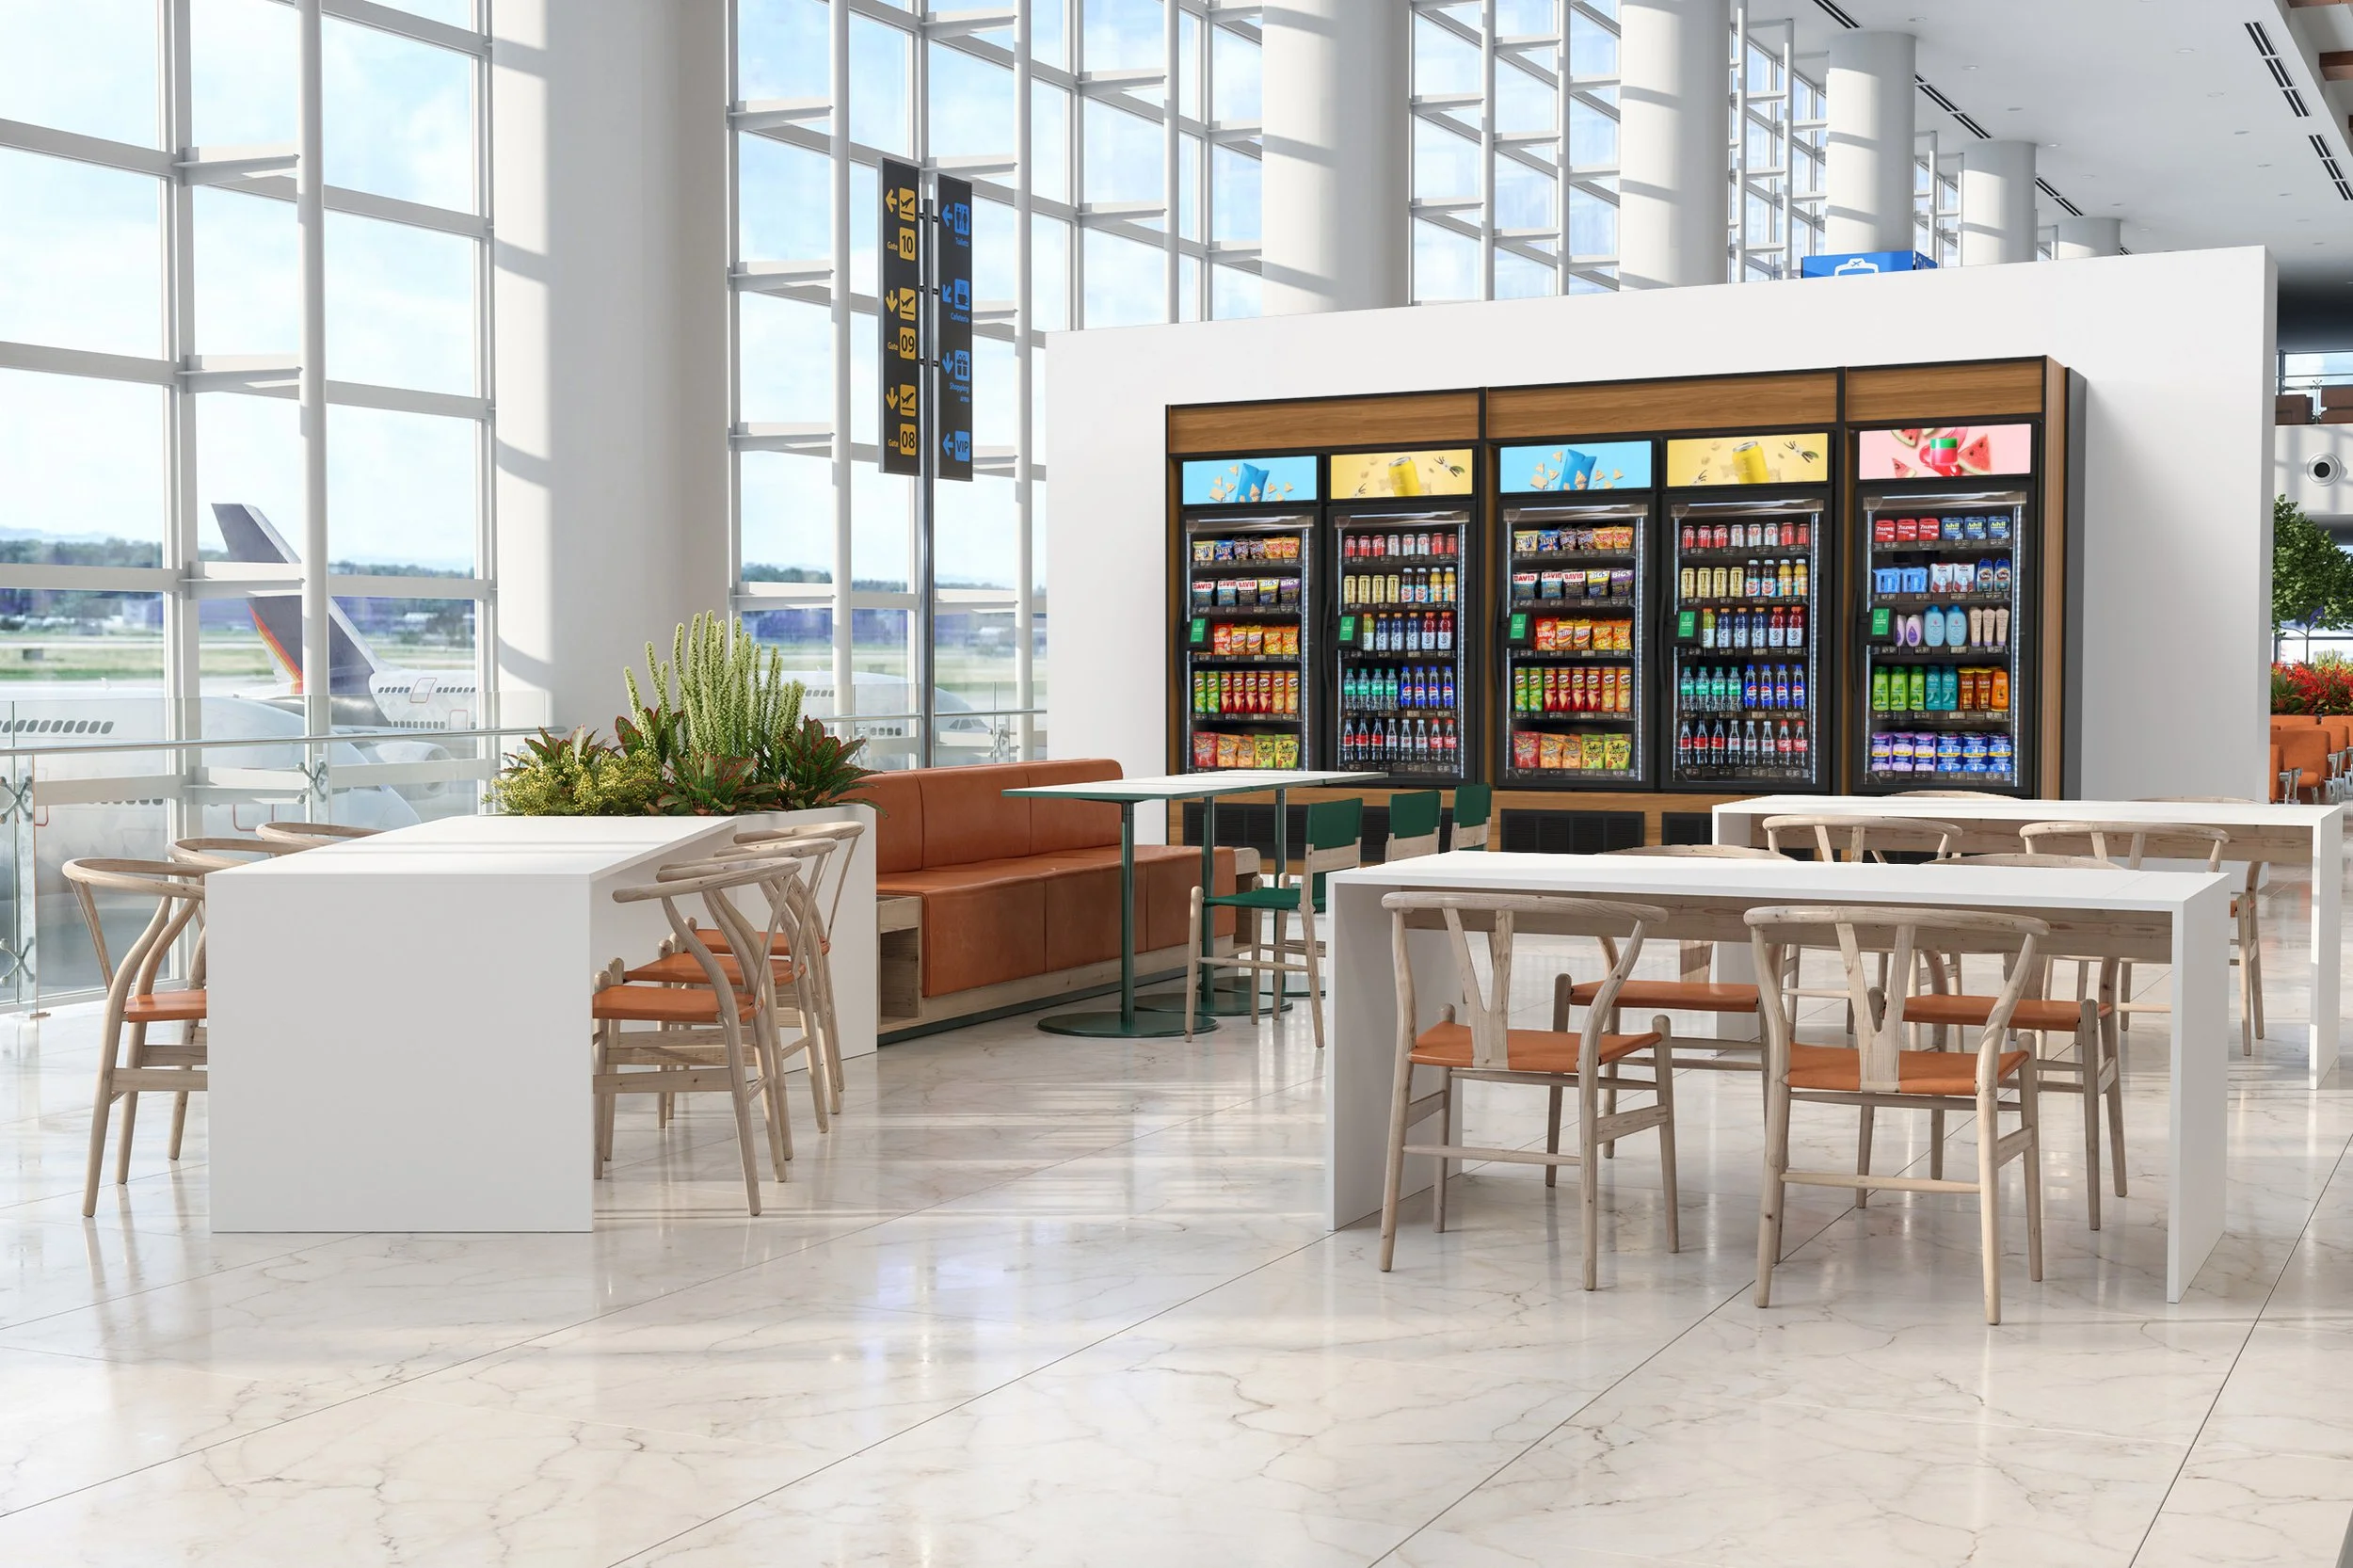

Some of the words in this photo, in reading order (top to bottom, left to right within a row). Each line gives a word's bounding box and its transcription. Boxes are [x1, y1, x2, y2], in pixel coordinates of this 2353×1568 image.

[887, 241, 898, 251] Gate
[902, 234, 913, 254] 10
[950, 312, 969, 324] Cafeteria
[887, 341, 899, 351] Gate
[901, 334, 915, 353] 09
[949, 381, 969, 394] Shopping
[888, 439, 899, 448] Gate
[902, 430, 915, 449] 08
[955, 440, 968, 453] VIP
